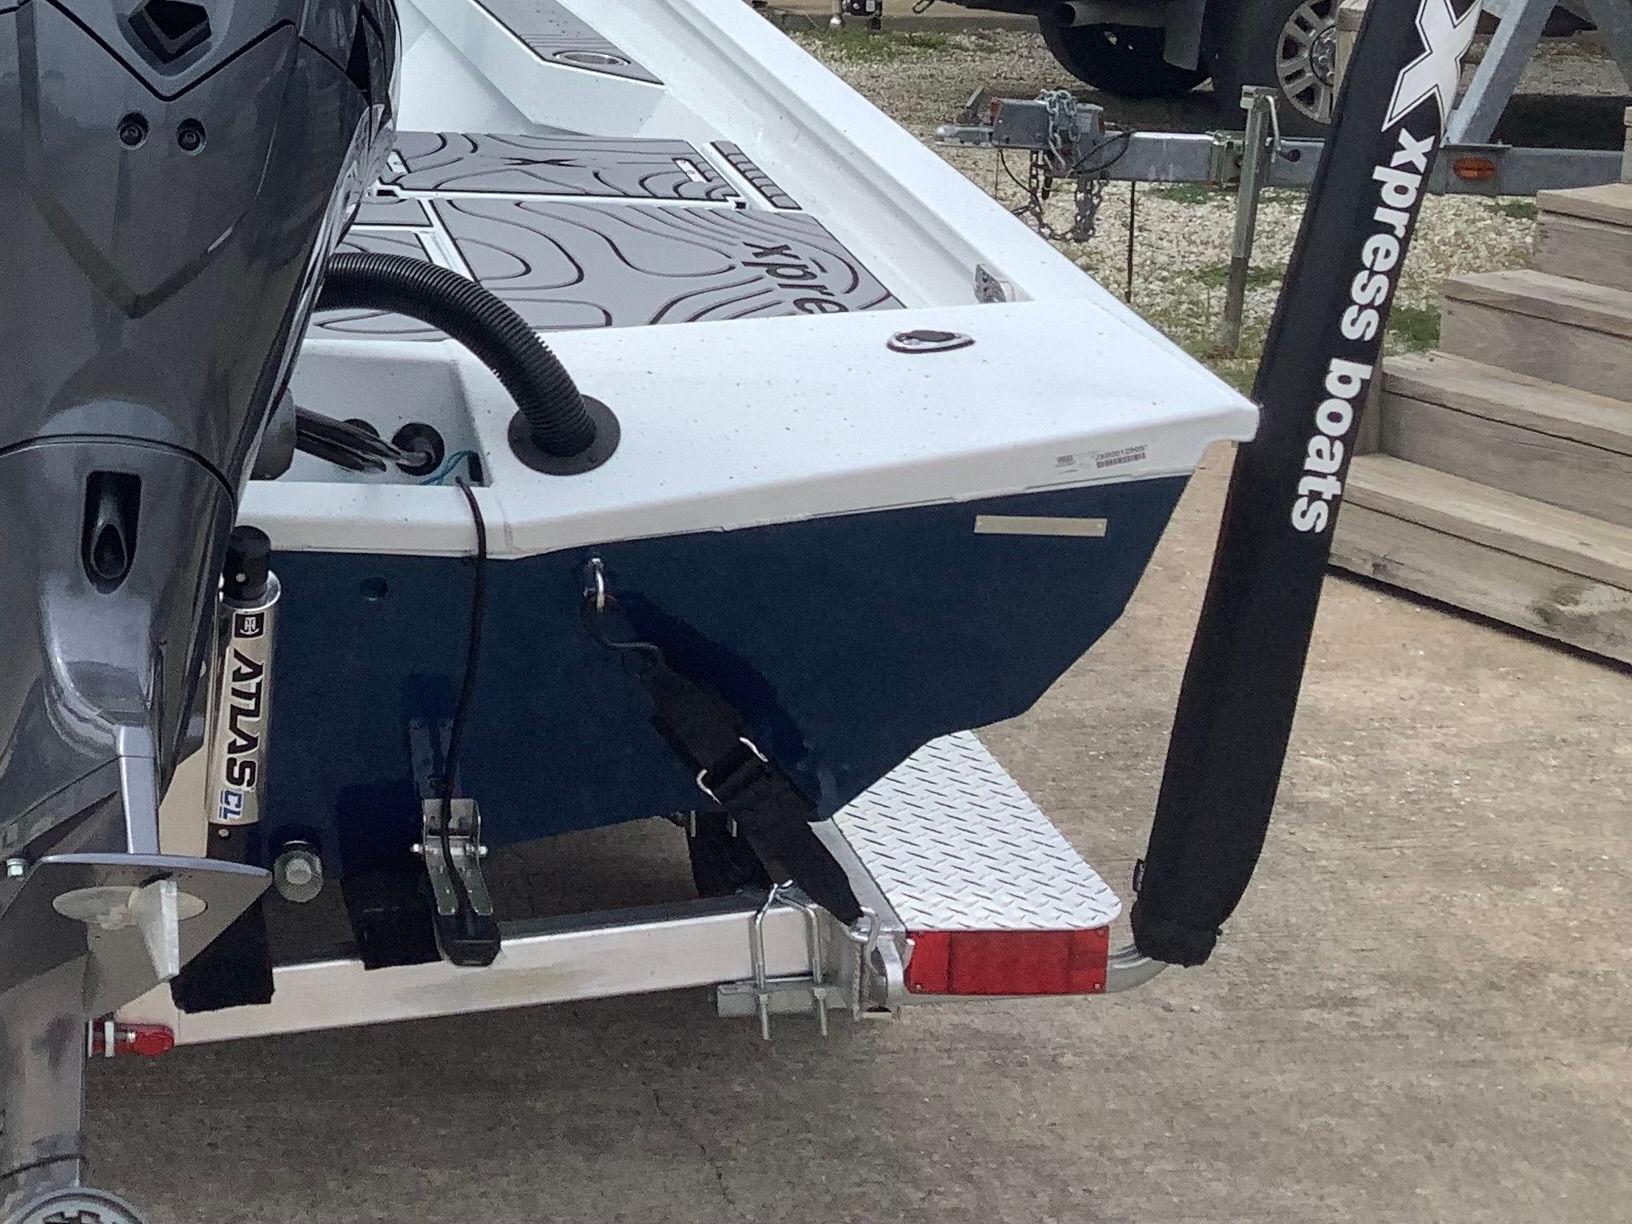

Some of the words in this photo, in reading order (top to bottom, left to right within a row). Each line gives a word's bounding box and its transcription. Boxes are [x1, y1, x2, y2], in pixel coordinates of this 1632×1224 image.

[1341, 128, 1436, 342] xpress
[1291, 357, 1374, 534] boats
[226, 648, 265, 789] ATLAS
[218, 790, 243, 820] CL
